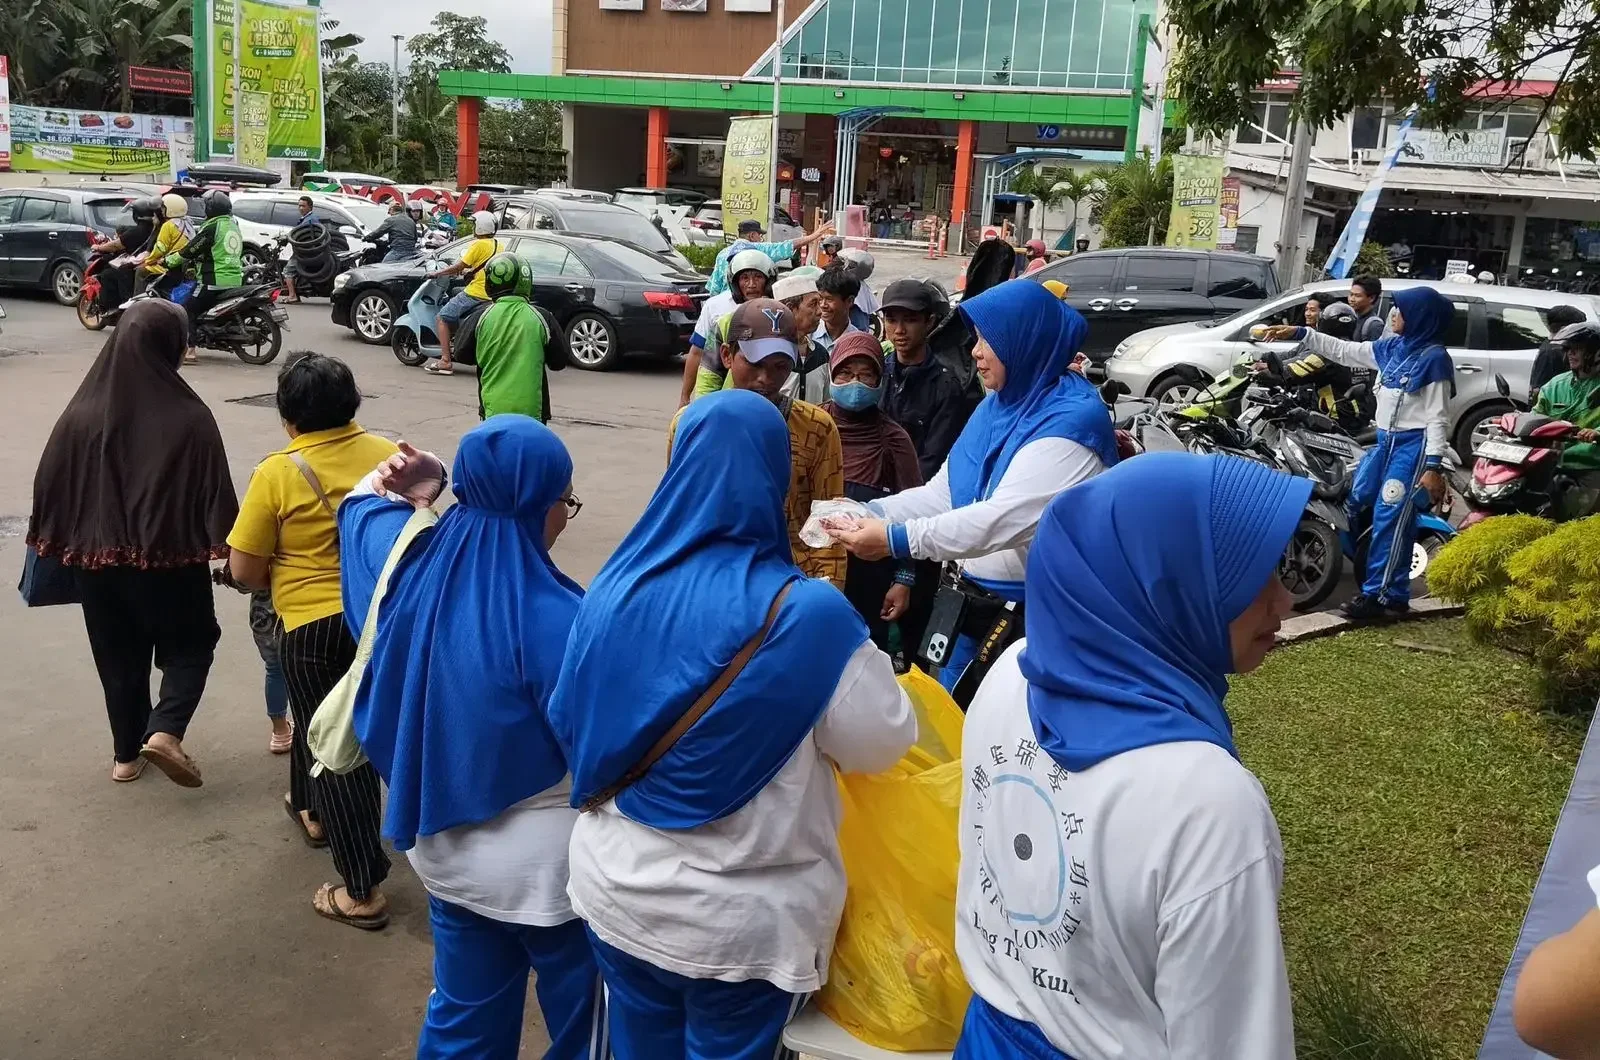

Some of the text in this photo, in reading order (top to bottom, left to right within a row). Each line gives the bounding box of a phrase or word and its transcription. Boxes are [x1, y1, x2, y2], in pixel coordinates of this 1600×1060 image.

[215, 4, 234, 13] HANY
[214, 12, 221, 21] 3
[250, 18, 294, 33] DISKON
[247, 33, 297, 48] LEBARAN
[225, 64, 261, 79] DSKON
[291, 73, 305, 94] 2
[272, 88, 316, 112] GRATIS 1
[243, 107, 267, 115] DSKON
[728, 141, 769, 152] LEBARAN
[732, 134, 767, 144] DISKON
[743, 165, 766, 181] 5%
[1180, 178, 1216, 188] DISKON
[724, 200, 753, 210] GRATIS
[1189, 218, 1213, 236] 5%
[761, 308, 784, 333] Y
[973, 911, 999, 954] Lng
